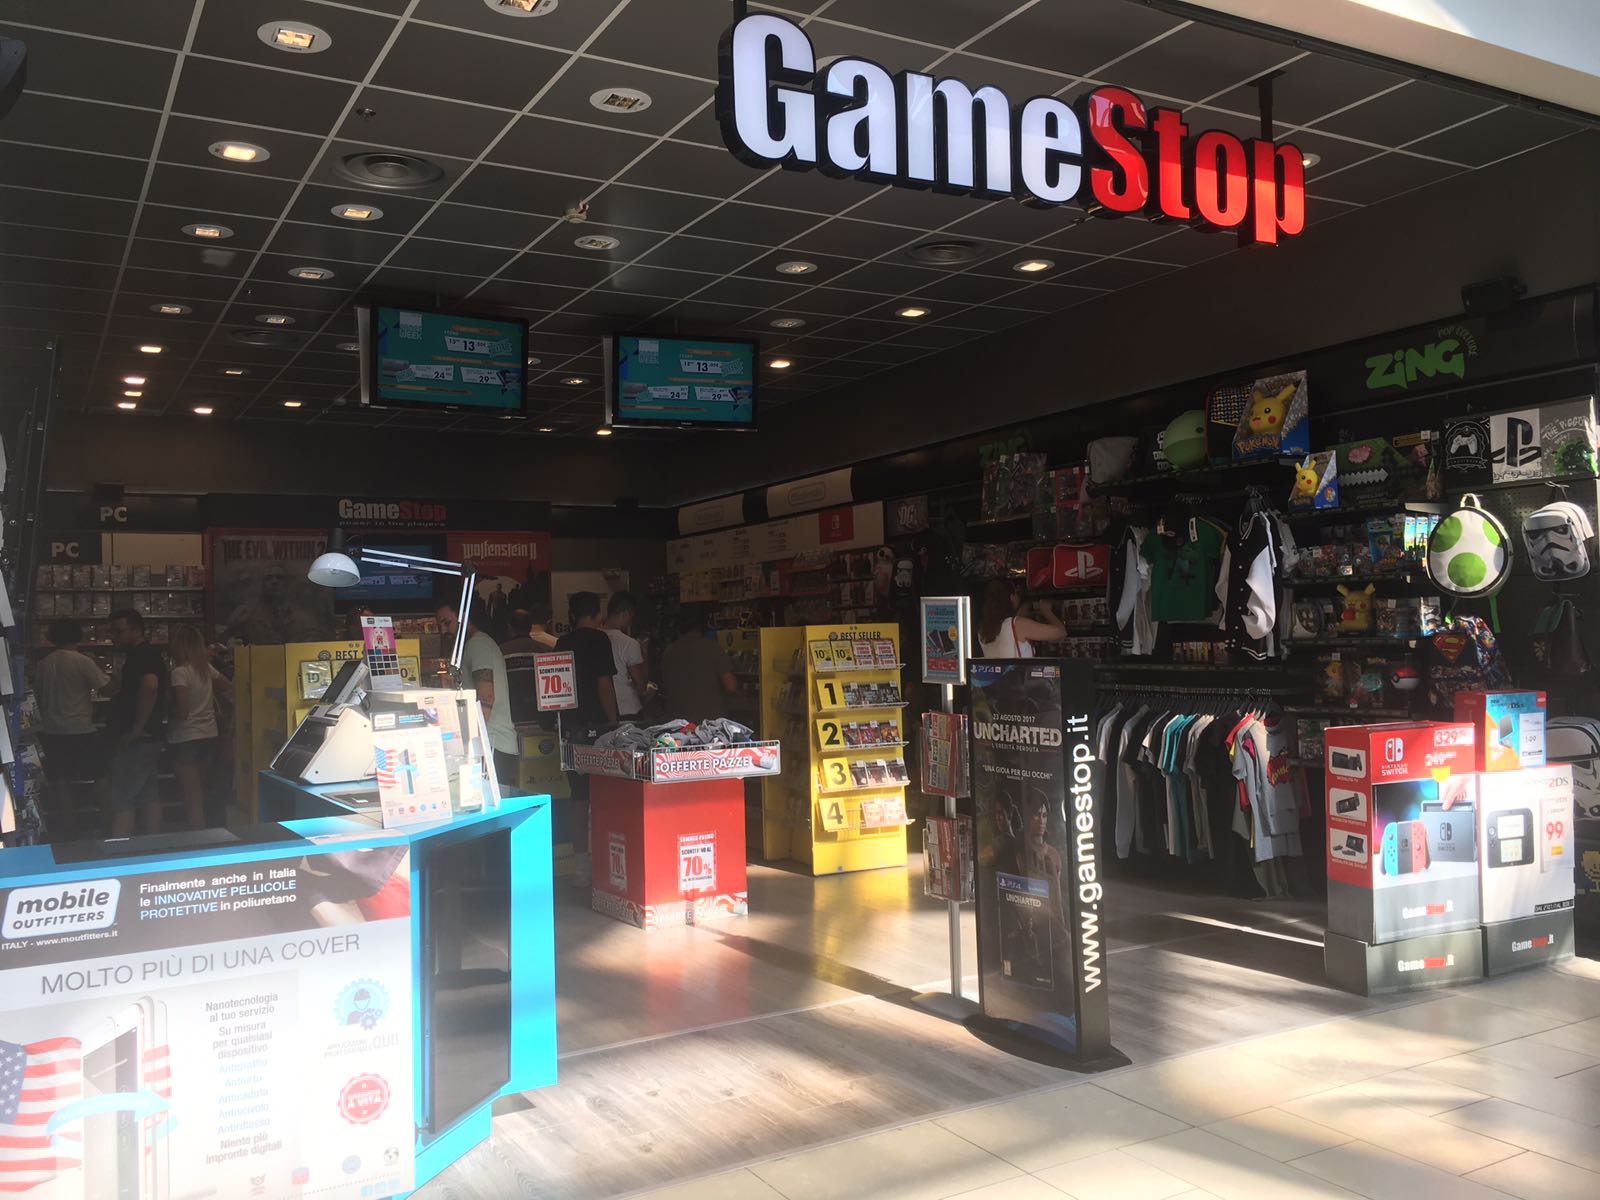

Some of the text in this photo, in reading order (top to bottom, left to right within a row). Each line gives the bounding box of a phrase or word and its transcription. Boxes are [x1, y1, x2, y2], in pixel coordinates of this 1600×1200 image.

[724, 12, 1306, 245] GameStop
[100, 506, 128, 523] PC
[338, 498, 447, 522] GameStop
[51, 542, 80, 558] PC
[840, 631, 881, 640] BEST SELLER
[335, 651, 359, 661] BEST
[823, 683, 837, 705] 1
[1000, 714, 1021, 722] AGOSTO
[822, 722, 841, 746] 2
[973, 722, 1063, 747] UNCHARTED
[576, 753, 621, 768] OFFERTE PAZZE
[659, 756, 751, 773] OFFERTE PAZZE
[830, 763, 847, 786] 3
[1011, 768, 1021, 776] PER
[1382, 767, 1409, 776] SWITCH
[1549, 776, 1569, 788] 2DS
[827, 802, 844, 825] 4
[1546, 822, 1565, 840] 99
[1066, 714, 1103, 993] www.gamestop.it
[683, 855, 713, 877] 70%
[140, 868, 296, 894] Finalmente anche in Italia
[17, 888, 110, 914] mobile
[140, 880, 297, 907] le INNOVATIVE PELLICOLE
[1006, 893, 1042, 908] UNCHARTED
[140, 894, 297, 921] PROTETTIVE in poliuretano
[12, 911, 105, 930] OUTFITTERS
[1, 941, 28, 951] ITALY
[36, 930, 118, 946] www.moutfitters.it
[41, 934, 361, 994] MOLTO PIÙ DI UNA COVER
[205, 993, 278, 1012] Nanotecnologia
[209, 1005, 275, 1023] al tuo servizio
[218, 1022, 266, 1036] Su misura
[212, 1039, 227, 1050] per
[217, 1043, 268, 1059] dispositivo
